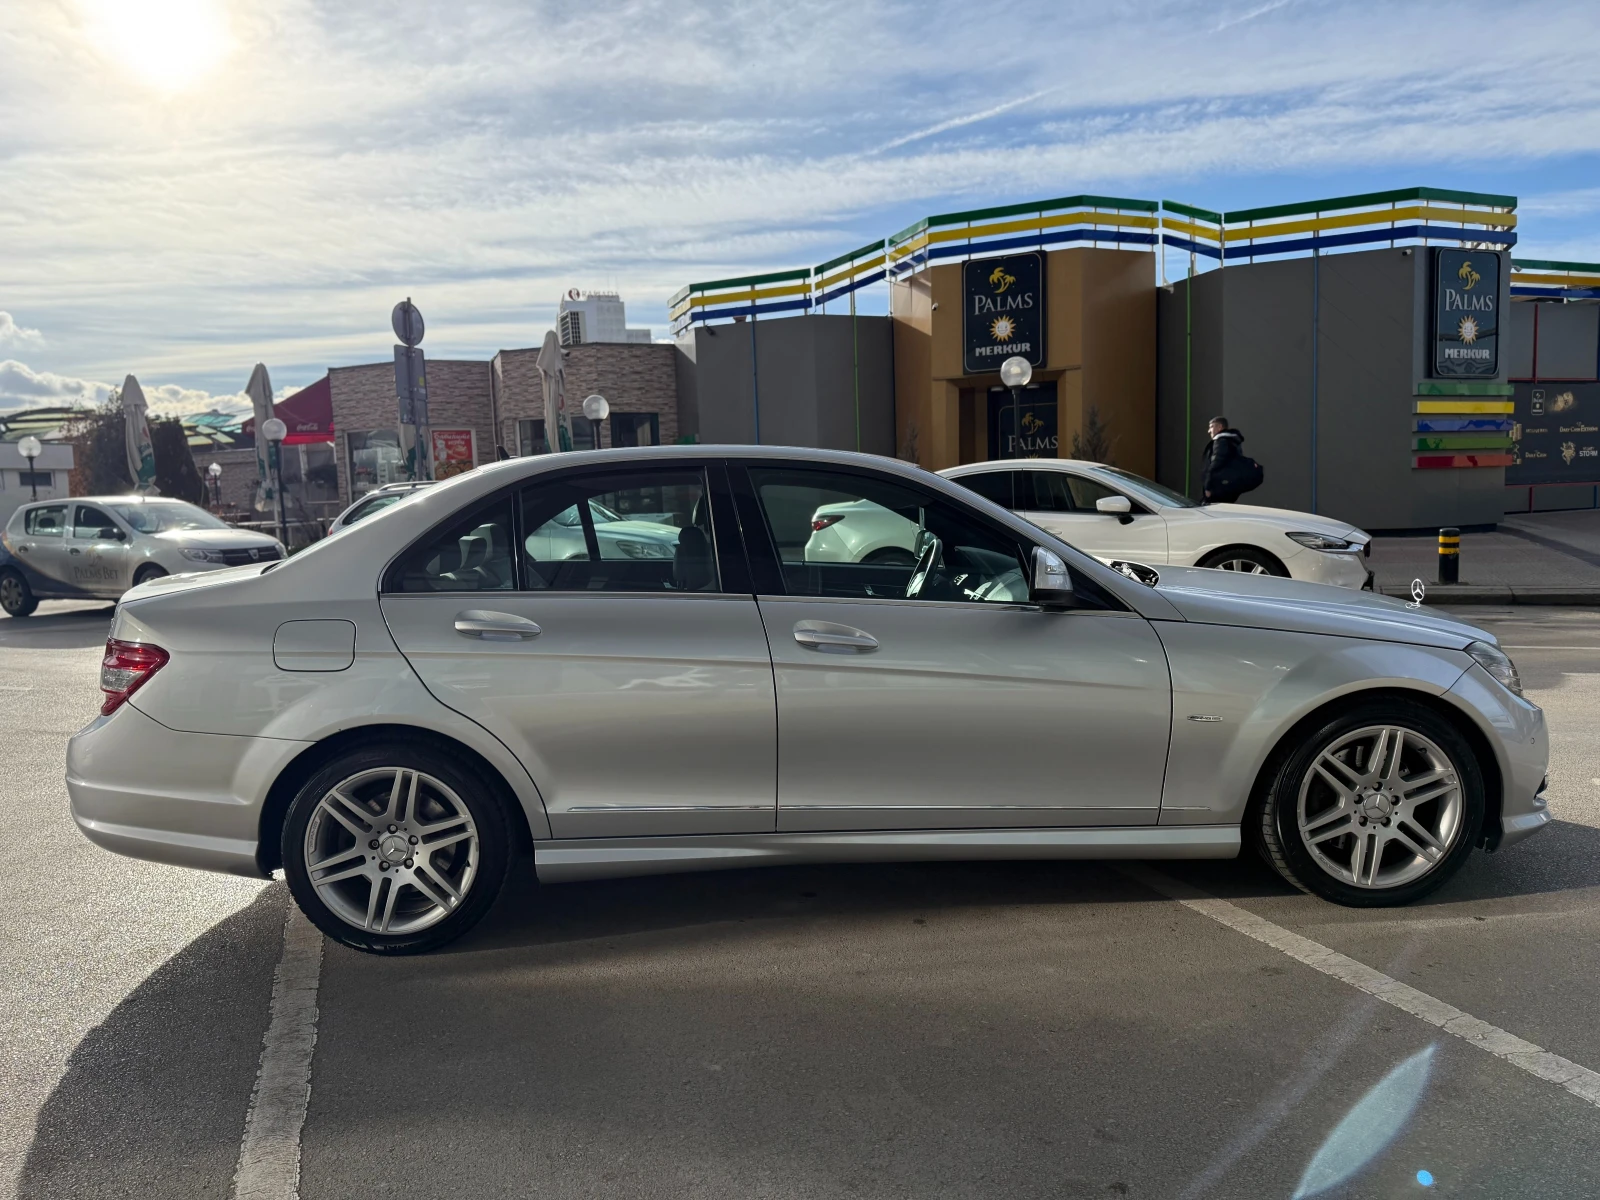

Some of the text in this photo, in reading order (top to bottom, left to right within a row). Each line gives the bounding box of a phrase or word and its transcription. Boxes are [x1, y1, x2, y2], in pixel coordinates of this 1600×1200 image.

[973, 292, 1033, 315] PALMS
[1444, 288, 1493, 311] PALMS
[975, 342, 1031, 357] MERKUR
[1444, 348, 1490, 359] MERKUR
[1008, 435, 1059, 452] PALMS
